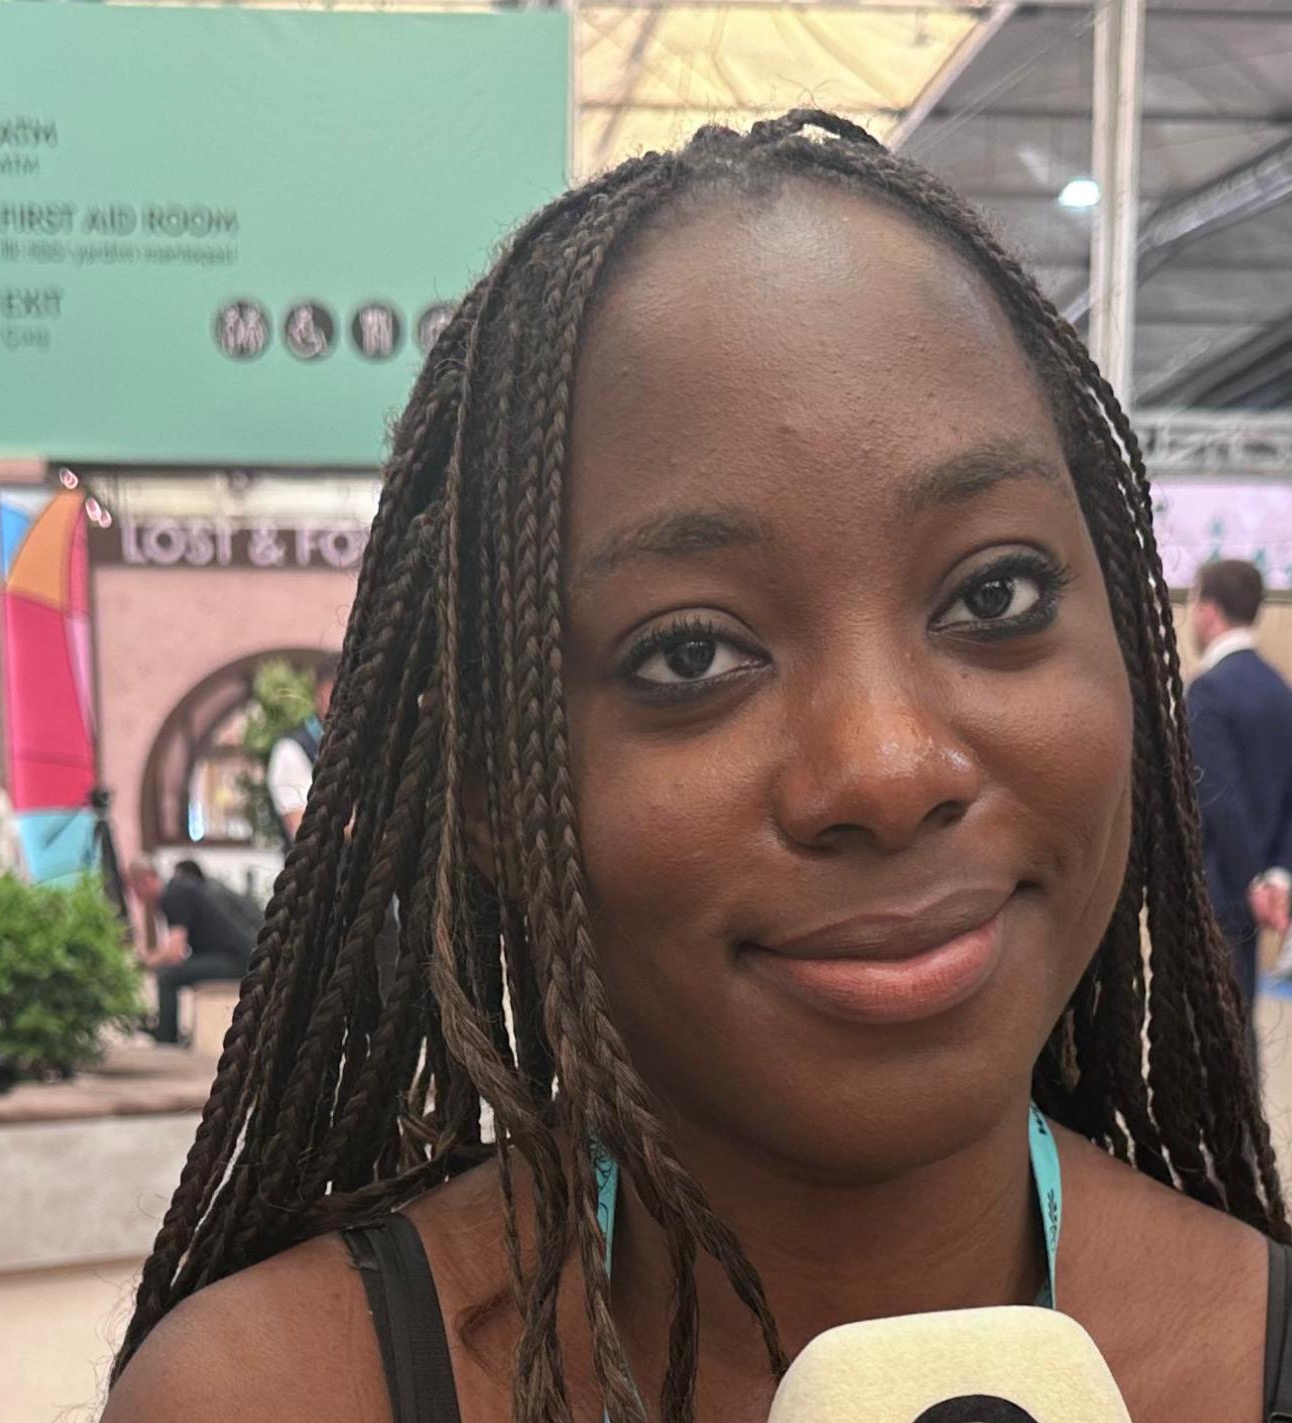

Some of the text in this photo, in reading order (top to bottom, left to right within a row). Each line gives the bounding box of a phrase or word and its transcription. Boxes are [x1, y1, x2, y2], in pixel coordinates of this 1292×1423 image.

[82, 203, 137, 236] AID
[142, 204, 239, 238] ROOM
[0, 286, 63, 318] EXIT
[121, 515, 371, 568] LOST & FO
